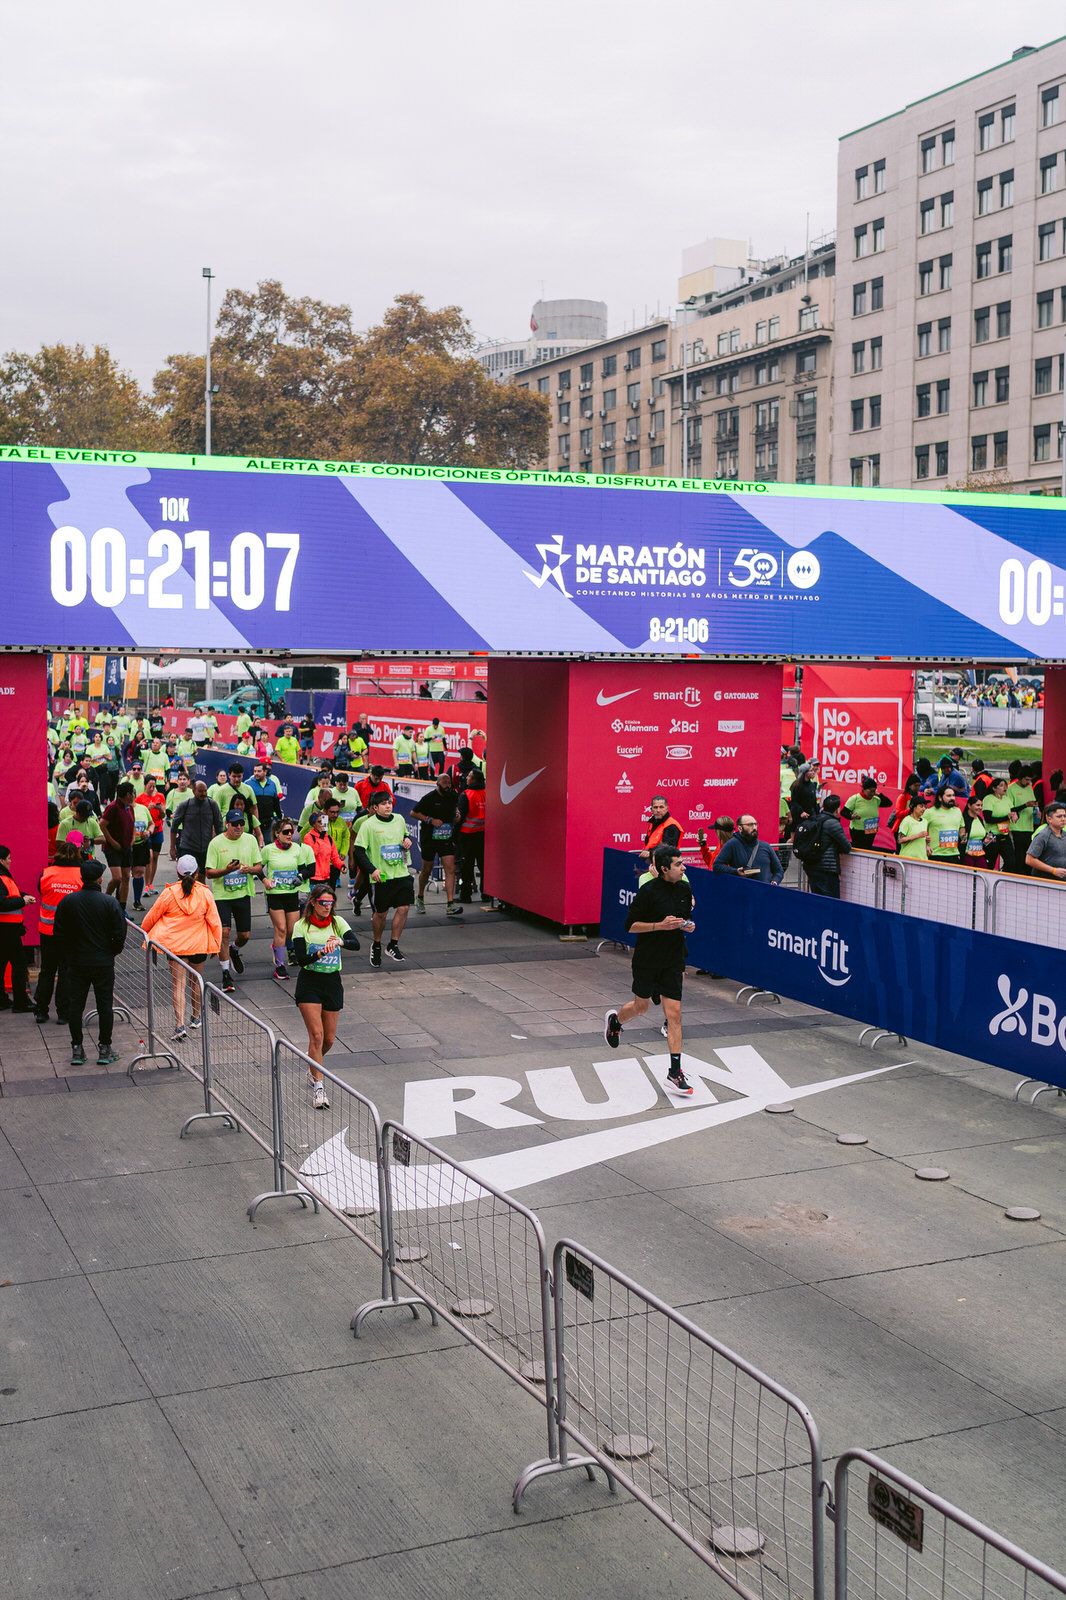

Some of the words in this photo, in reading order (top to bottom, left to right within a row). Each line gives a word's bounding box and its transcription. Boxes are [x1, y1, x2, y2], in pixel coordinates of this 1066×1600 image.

[27, 448, 51, 460] EL
[55, 451, 137, 464] EVENTO
[246, 459, 320, 473] ALERTA
[324, 463, 366, 474] SAE:
[371, 465, 502, 480] CONDICIONES
[505, 469, 591, 486] ÓPTIMAS,
[595, 475, 678, 489] DISFRUTA
[682, 479, 700, 490] EL
[703, 481, 769, 494] EVENTO.
[159, 497, 189, 522] 10K
[576, 541, 705, 569] MARATÓN
[50, 525, 300, 612] 00:21:07
[576, 566, 602, 583] DE
[607, 568, 706, 587] SANTIAGO
[576, 589, 637, 597] CONECTANDO
[640, 590, 687, 598] HISTORIAS
[649, 617, 709, 643] 8:21:06
[653, 690, 683, 700] smart
[685, 687, 701, 702] fit
[723, 692, 759, 700] GATORADE
[823, 708, 850, 727] No
[370, 723, 382, 742] No
[623, 724, 659, 732] Alemana
[681, 720, 699, 733] Bci
[823, 726, 894, 746] Prokart
[616, 745, 642, 754] Eucerin
[714, 746, 738, 757] SKY
[822, 747, 850, 765] No
[656, 778, 690, 787] ACUVUE
[703, 778, 738, 787] SUBWAY
[688, 809, 711, 820] Downy
[51, 882, 78, 890] SEGURIDAD
[767, 928, 818, 960] smart
[820, 928, 849, 974] fit
[403, 1044, 792, 1139] RUN
